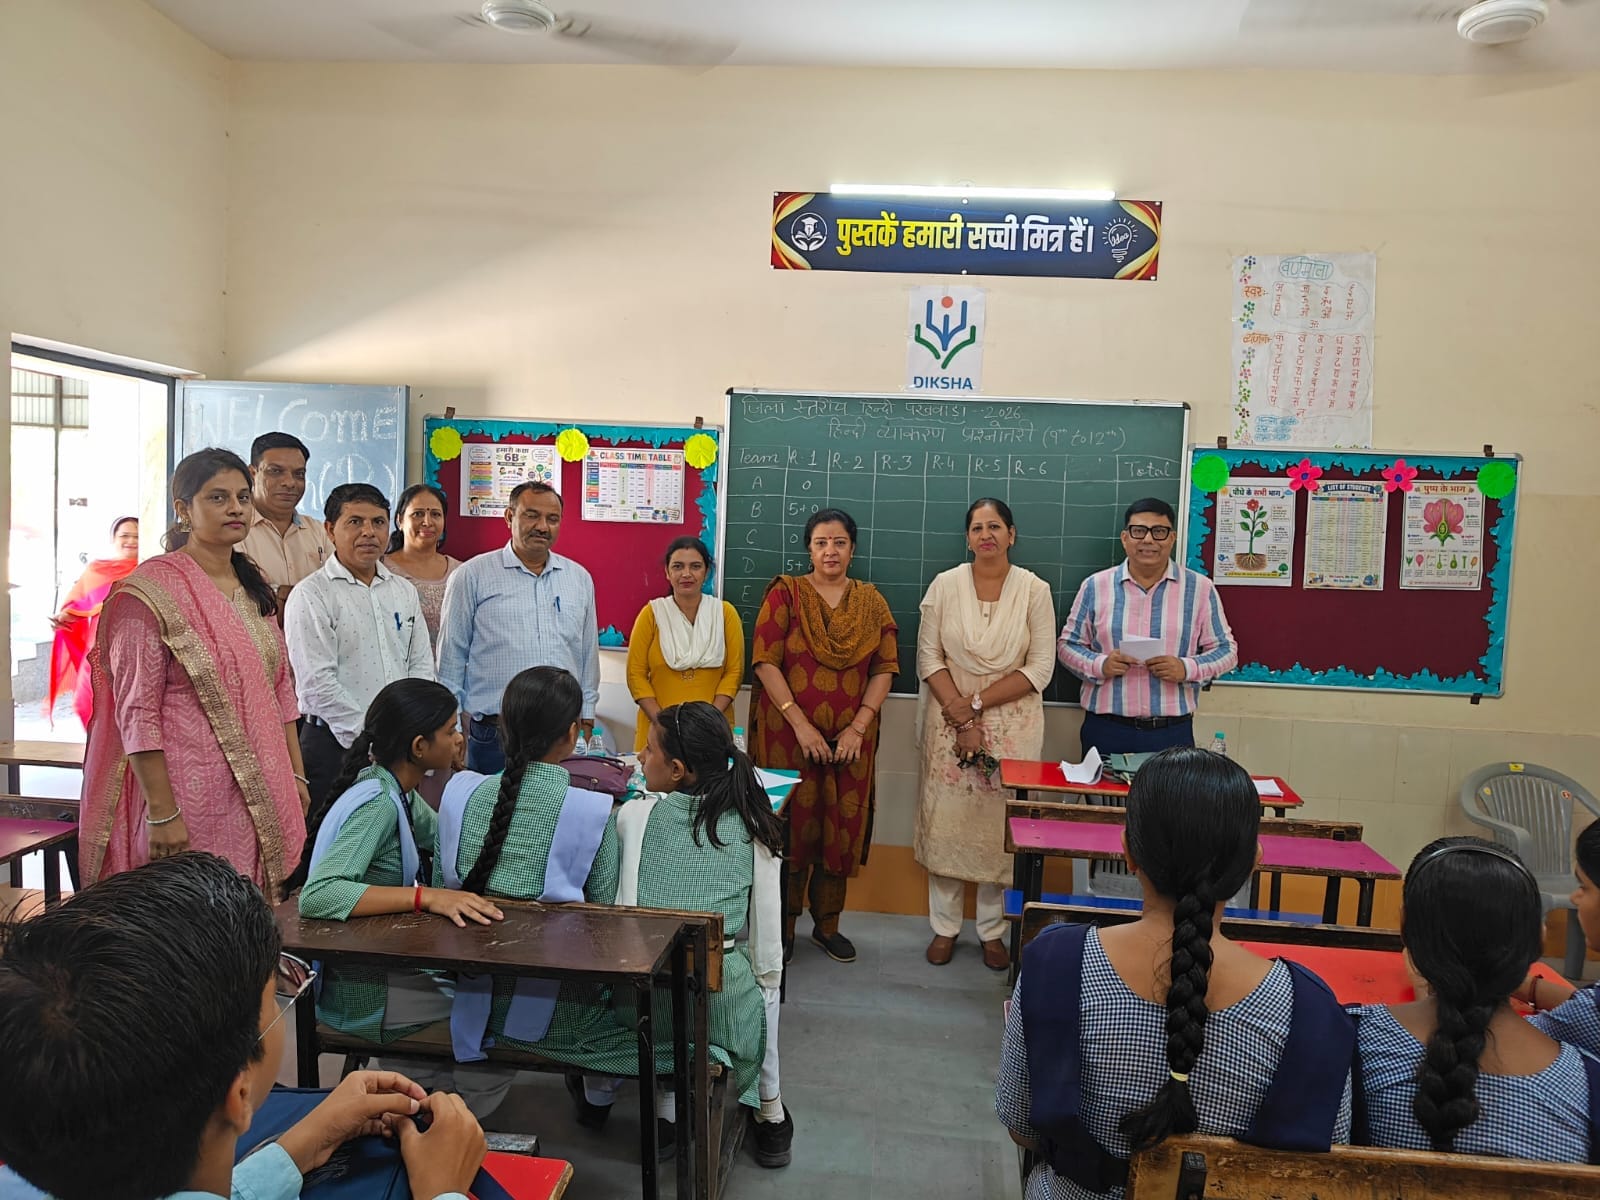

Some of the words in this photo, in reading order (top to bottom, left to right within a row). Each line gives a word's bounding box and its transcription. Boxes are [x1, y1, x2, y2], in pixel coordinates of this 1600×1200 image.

[836, 211, 898, 256] पुस्तकें
[901, 213, 966, 250] हमारी
[967, 215, 1020, 251] सच्ची
[1022, 215, 1067, 252] मित्र
[913, 376, 973, 390] DIKSHA
[741, 395, 785, 415] जिला
[793, 398, 848, 416] स्तरीय
[828, 417, 867, 439] हिन्दी
[877, 425, 946, 443] व्याकरण
[504, 453, 519, 462] 6B
[600, 452, 625, 460] CLASS
[627, 452, 647, 460] TIME
[648, 453, 672, 462] TABLE
[739, 448, 780, 464] Team
[1123, 461, 1171, 478] Total
[752, 476, 762, 489] A
[1440, 483, 1448, 492] के
[750, 501, 762, 518] B
[746, 528, 758, 544] C
[742, 556, 755, 573] D
[741, 585, 752, 602] E
